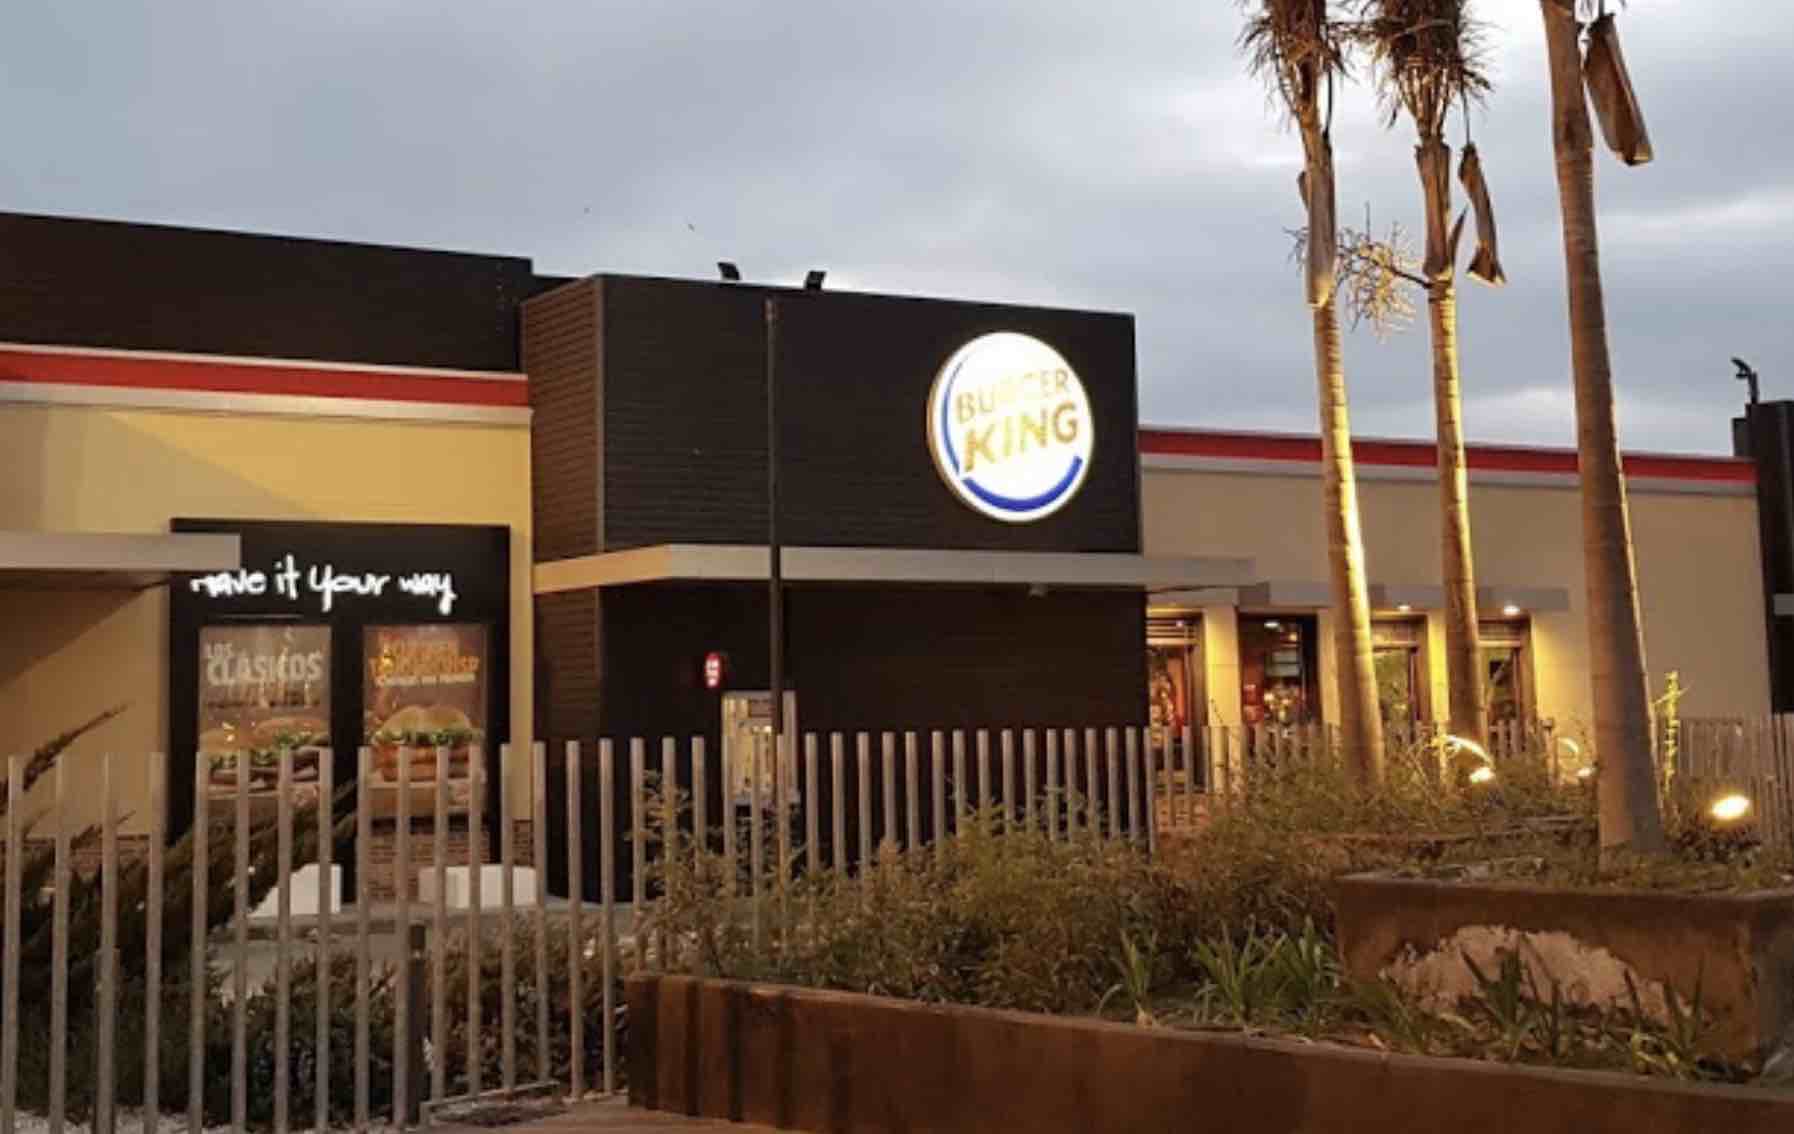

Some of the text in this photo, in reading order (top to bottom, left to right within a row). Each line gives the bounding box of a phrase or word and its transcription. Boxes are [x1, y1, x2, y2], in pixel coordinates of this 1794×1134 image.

[955, 367, 1070, 424] BUER
[963, 401, 1079, 473] KING
[275, 553, 300, 600] it
[399, 572, 457, 615] way
